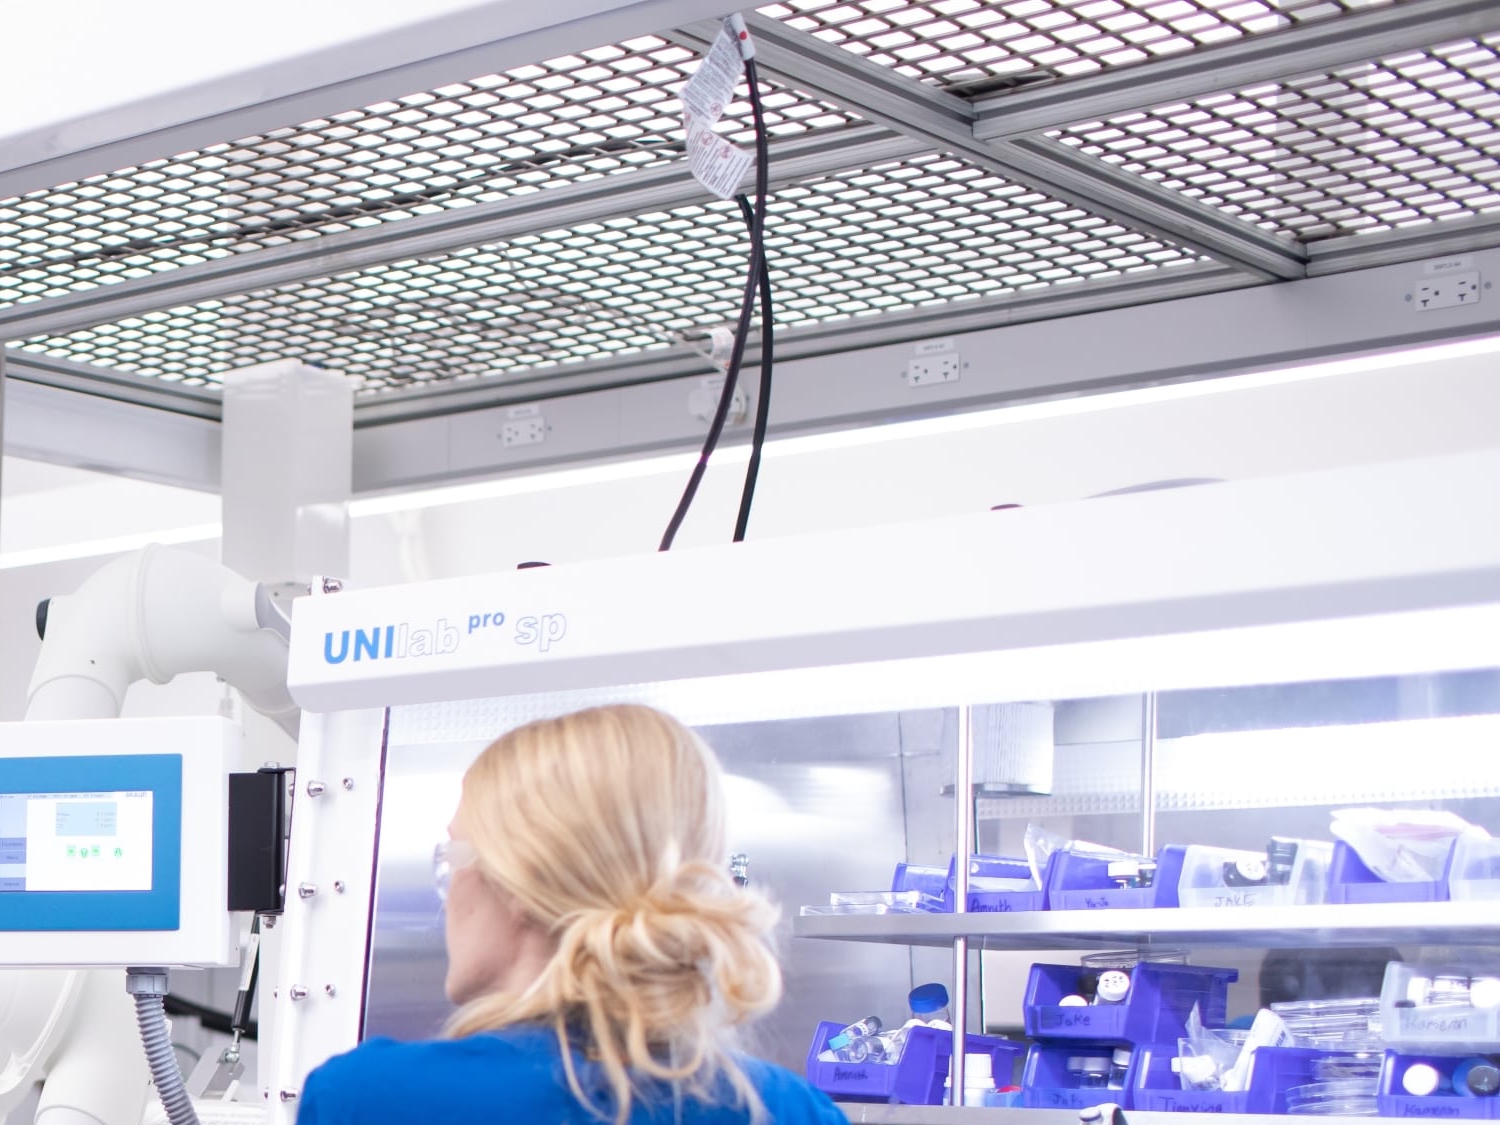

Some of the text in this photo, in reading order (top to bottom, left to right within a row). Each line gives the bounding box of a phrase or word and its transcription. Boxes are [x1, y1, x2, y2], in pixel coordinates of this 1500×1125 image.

[324, 611, 567, 665] UNIlab pro sp
